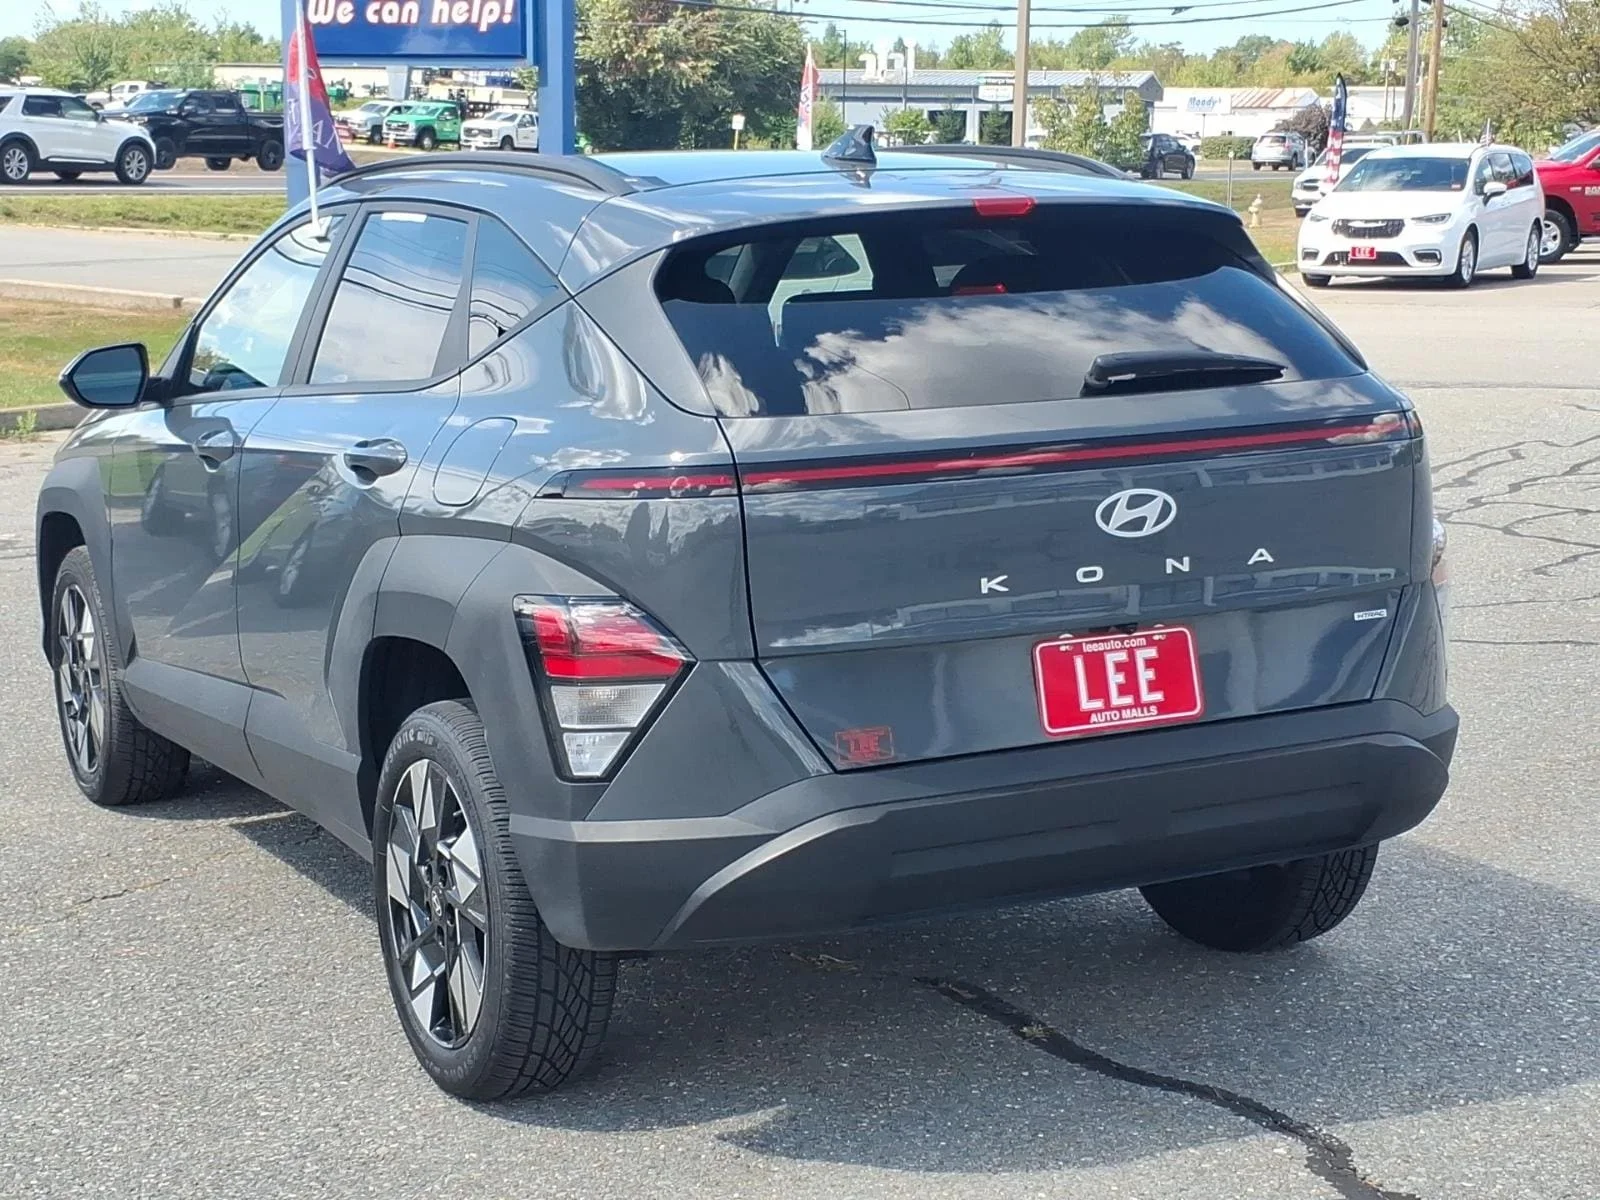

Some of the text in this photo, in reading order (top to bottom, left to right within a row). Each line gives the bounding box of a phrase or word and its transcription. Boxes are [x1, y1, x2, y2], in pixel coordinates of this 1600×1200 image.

[306, 0, 515, 33] We can help!
[1082, 636, 1147, 653] leeauto.com
[1073, 646, 1165, 712] LEE
[1089, 705, 1159, 725] AUTO MALLS
